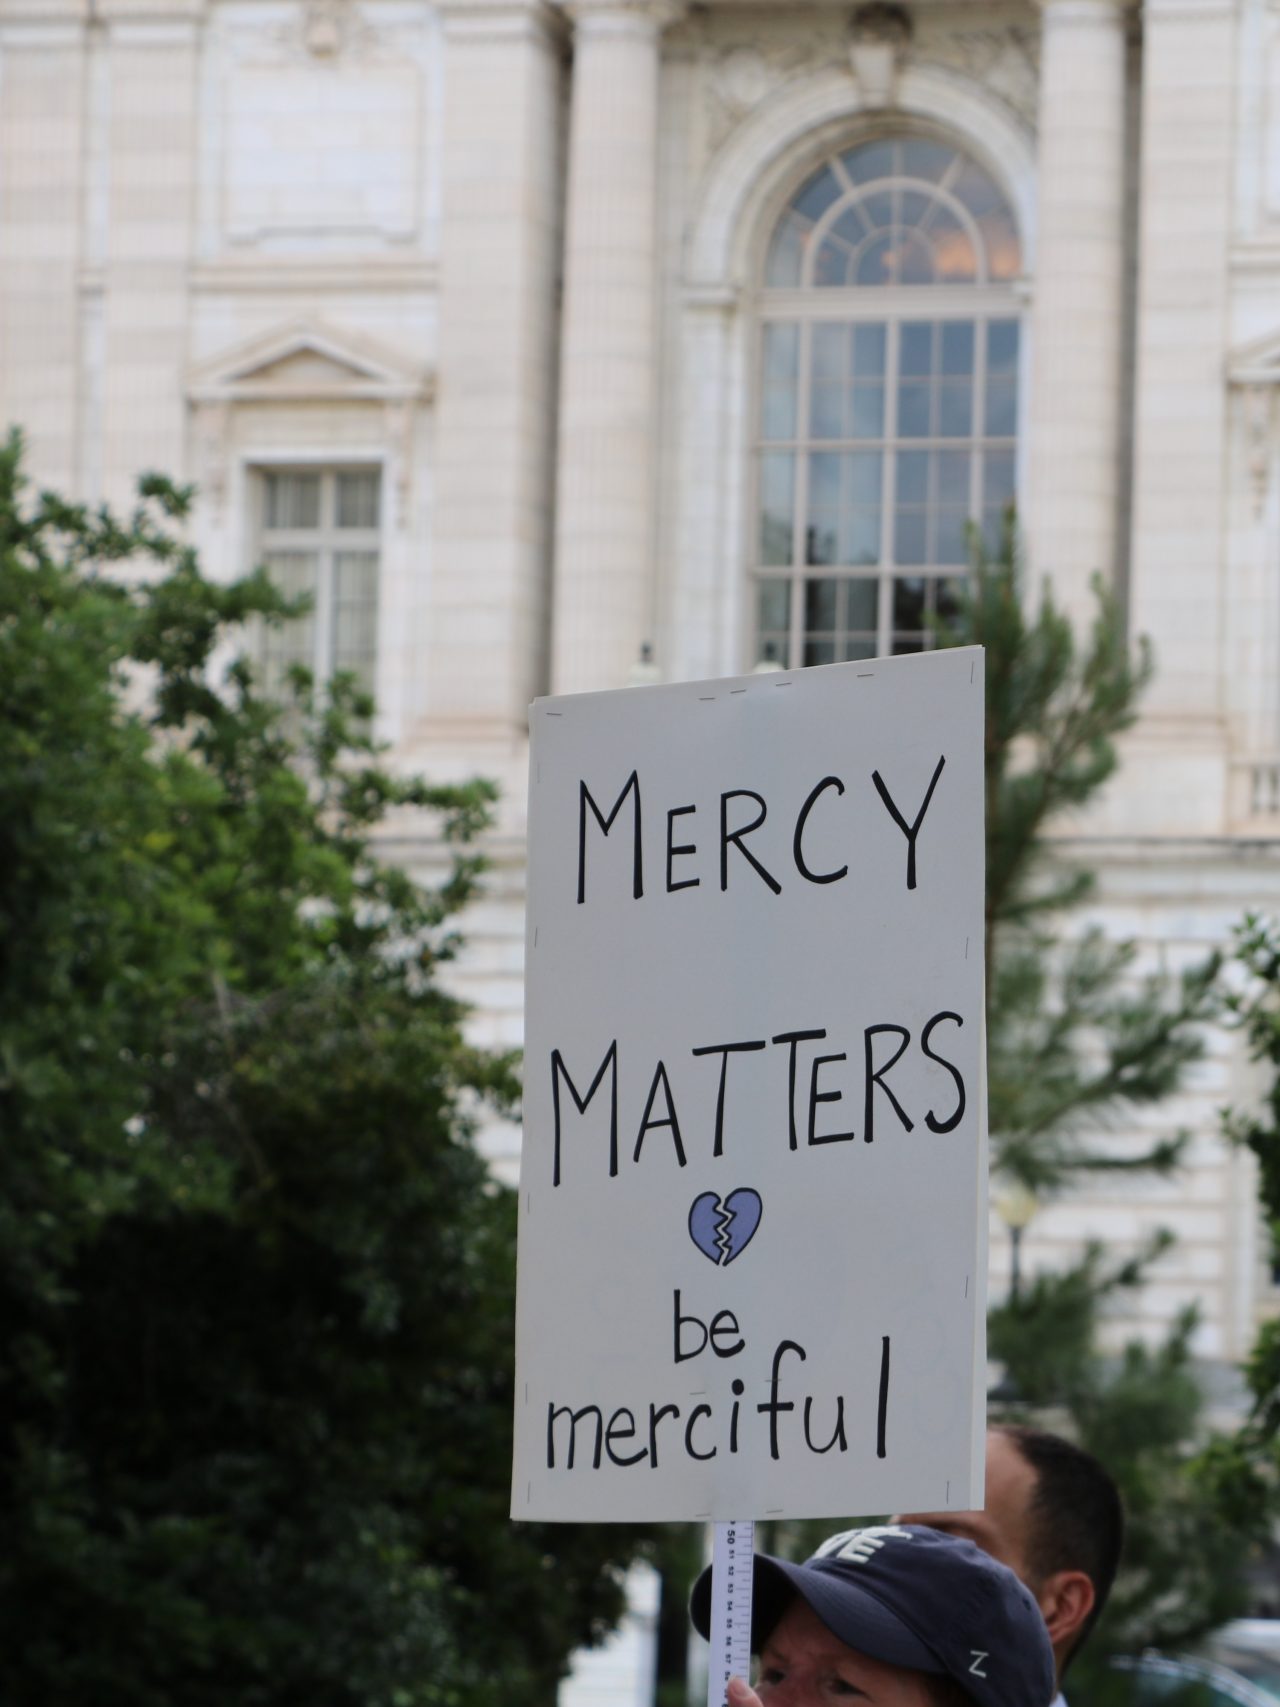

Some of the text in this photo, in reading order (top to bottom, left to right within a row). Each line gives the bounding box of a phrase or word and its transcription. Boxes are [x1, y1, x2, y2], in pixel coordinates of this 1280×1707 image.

[578, 755, 945, 904] MERCY
[551, 1011, 966, 1187] MATTERS
[674, 1289, 746, 1363] be
[547, 1336, 890, 1469] merciful
[727, 1529, 736, 1545] 50
